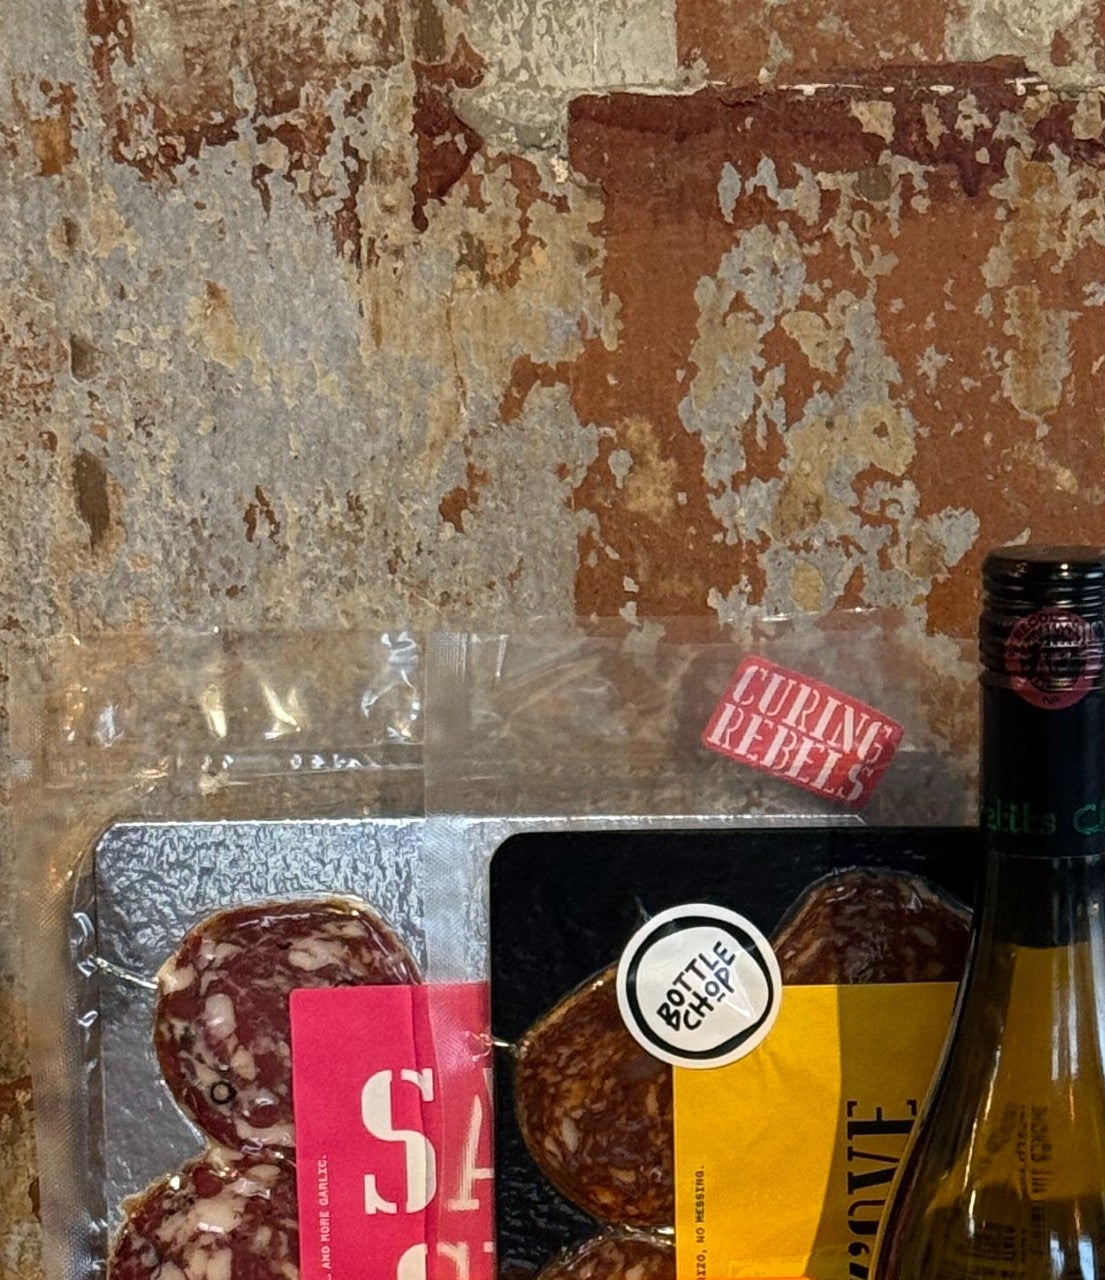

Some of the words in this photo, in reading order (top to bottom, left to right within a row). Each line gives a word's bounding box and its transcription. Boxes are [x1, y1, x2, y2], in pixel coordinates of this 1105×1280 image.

[732, 665, 893, 764] CURING
[707, 702, 874, 801] REBELS
[656, 941, 735, 1032] BOTTLE
[683, 967, 735, 1030] CHOP
[319, 1210, 331, 1242] MORE
[320, 1245, 332, 1269] AND
[695, 1227, 706, 1244] NO
